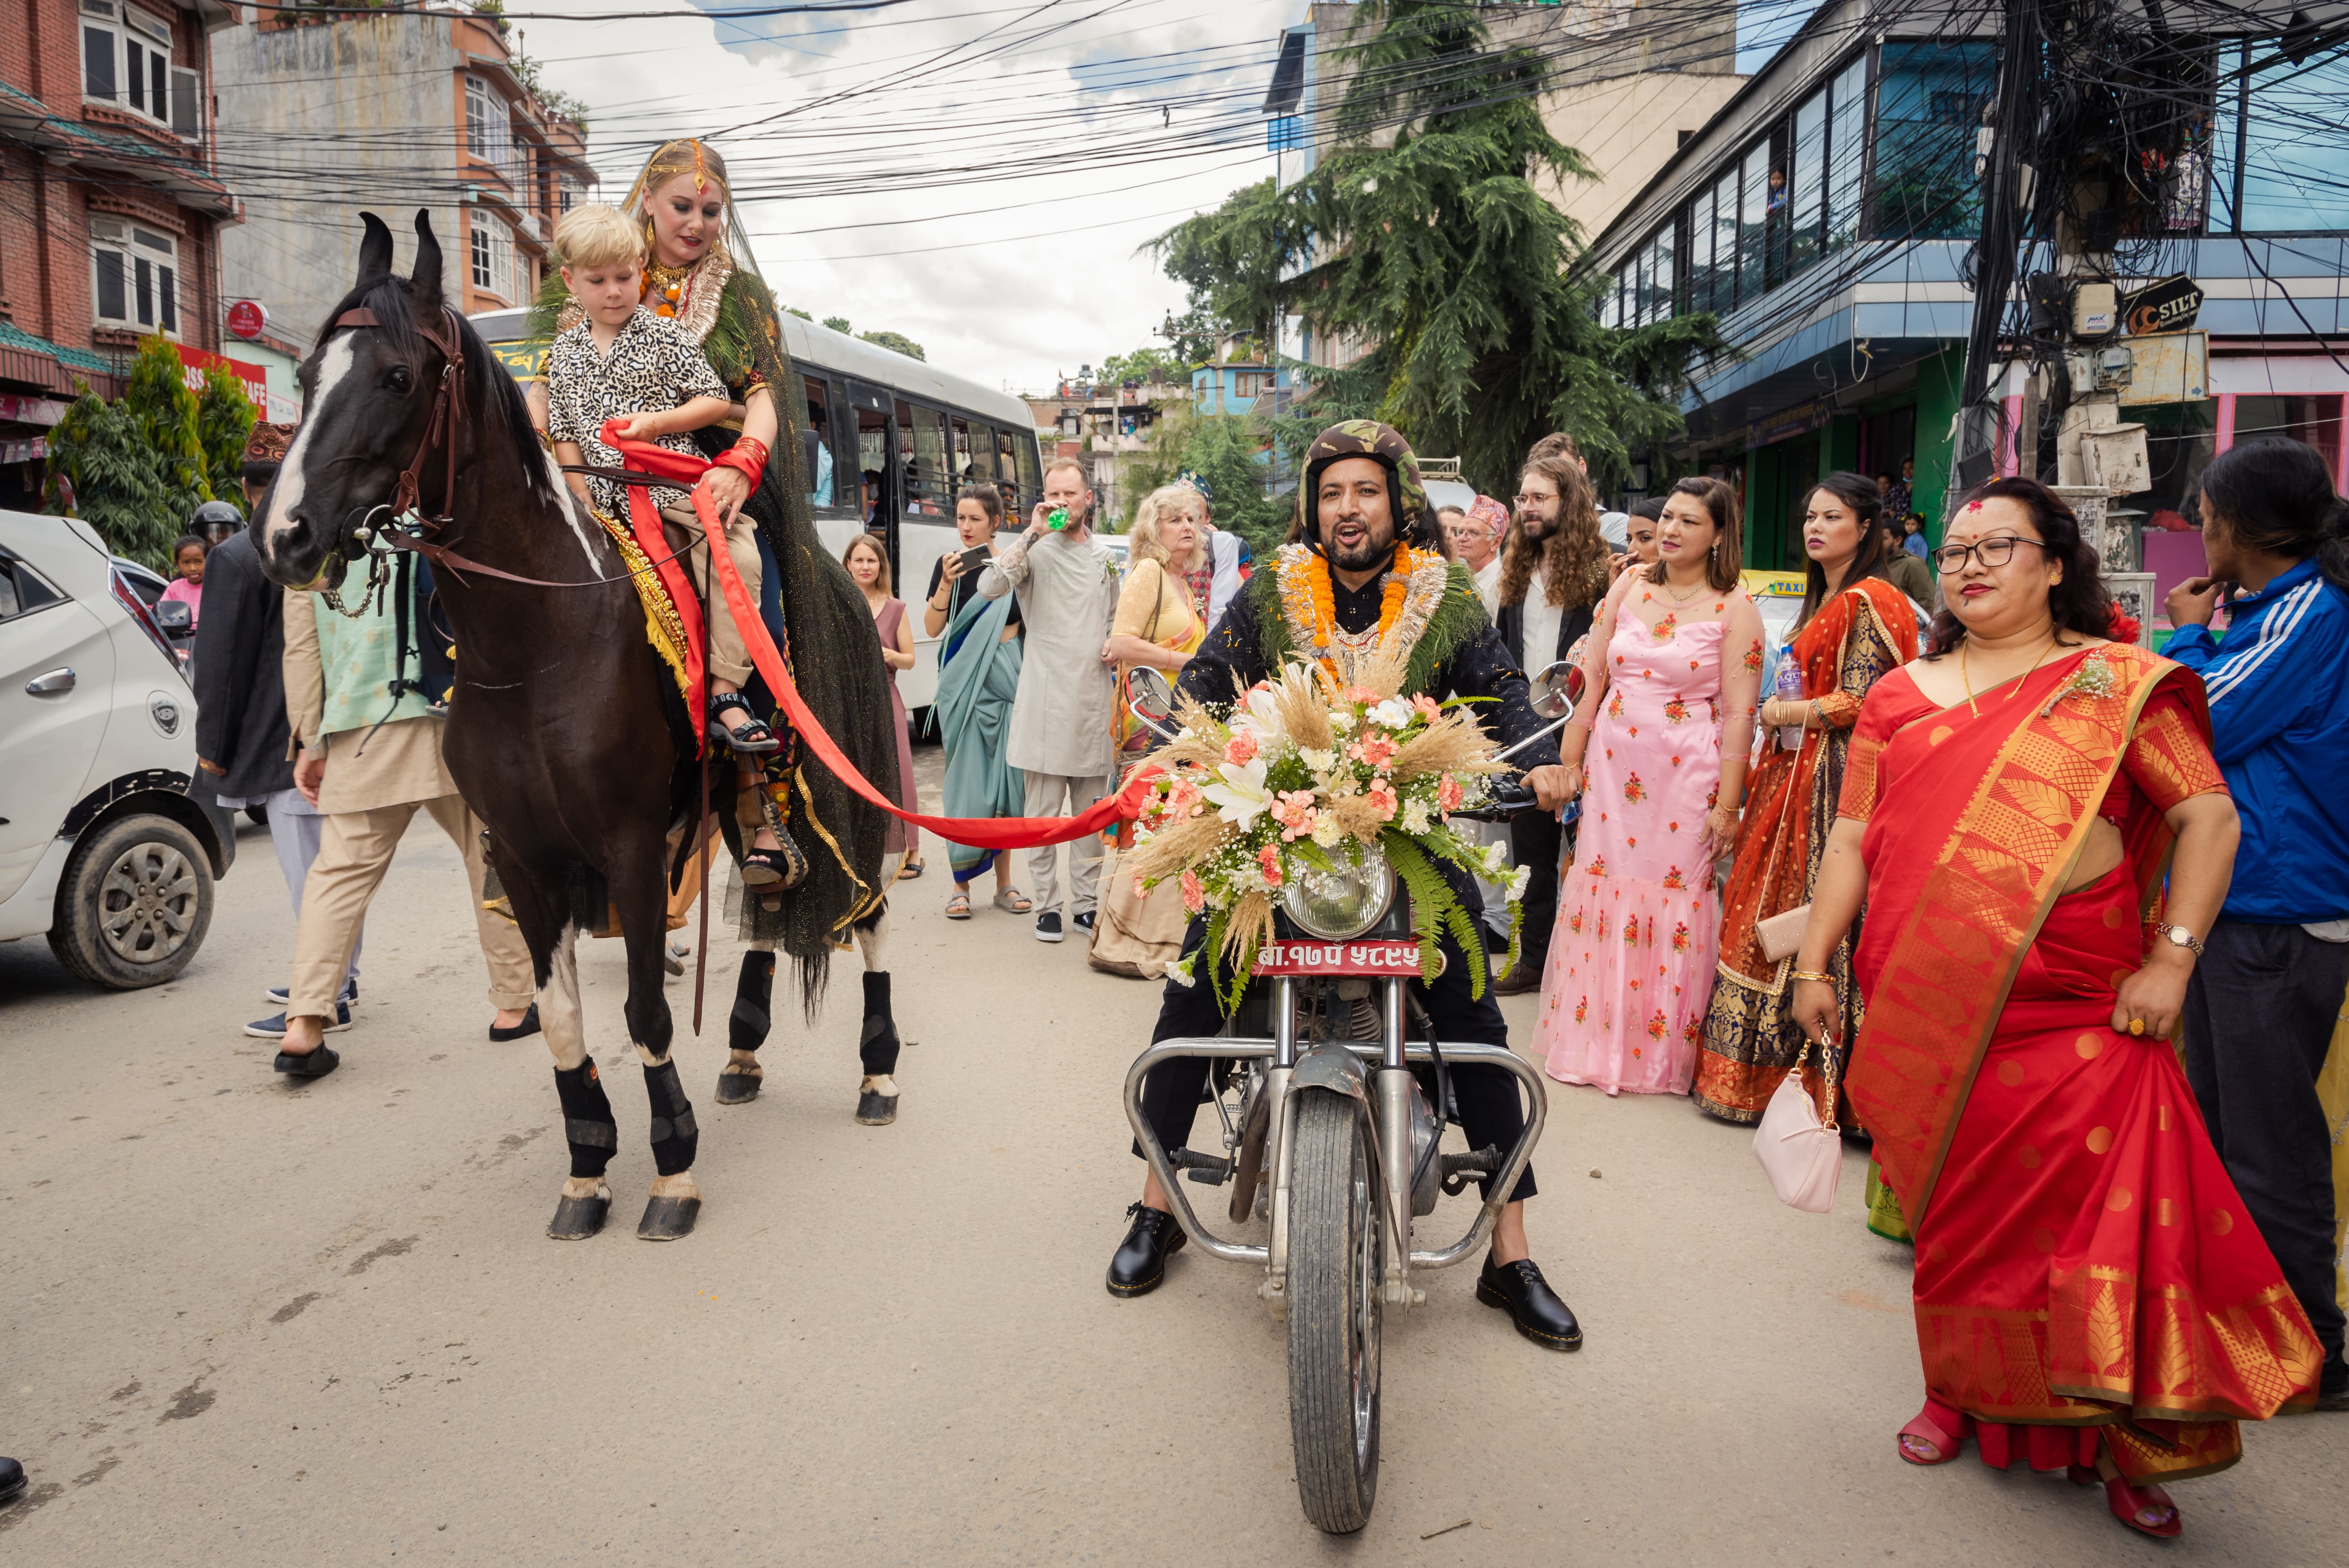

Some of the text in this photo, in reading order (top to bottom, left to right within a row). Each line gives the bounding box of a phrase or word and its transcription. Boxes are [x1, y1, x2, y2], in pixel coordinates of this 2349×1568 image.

[2159, 291, 2198, 319] SILT
[2087, 315, 2105, 323] MAX
[182, 364, 204, 391] OSS
[1777, 582, 1804, 592] TAXI
[1778, 672, 1801, 682] AQU
